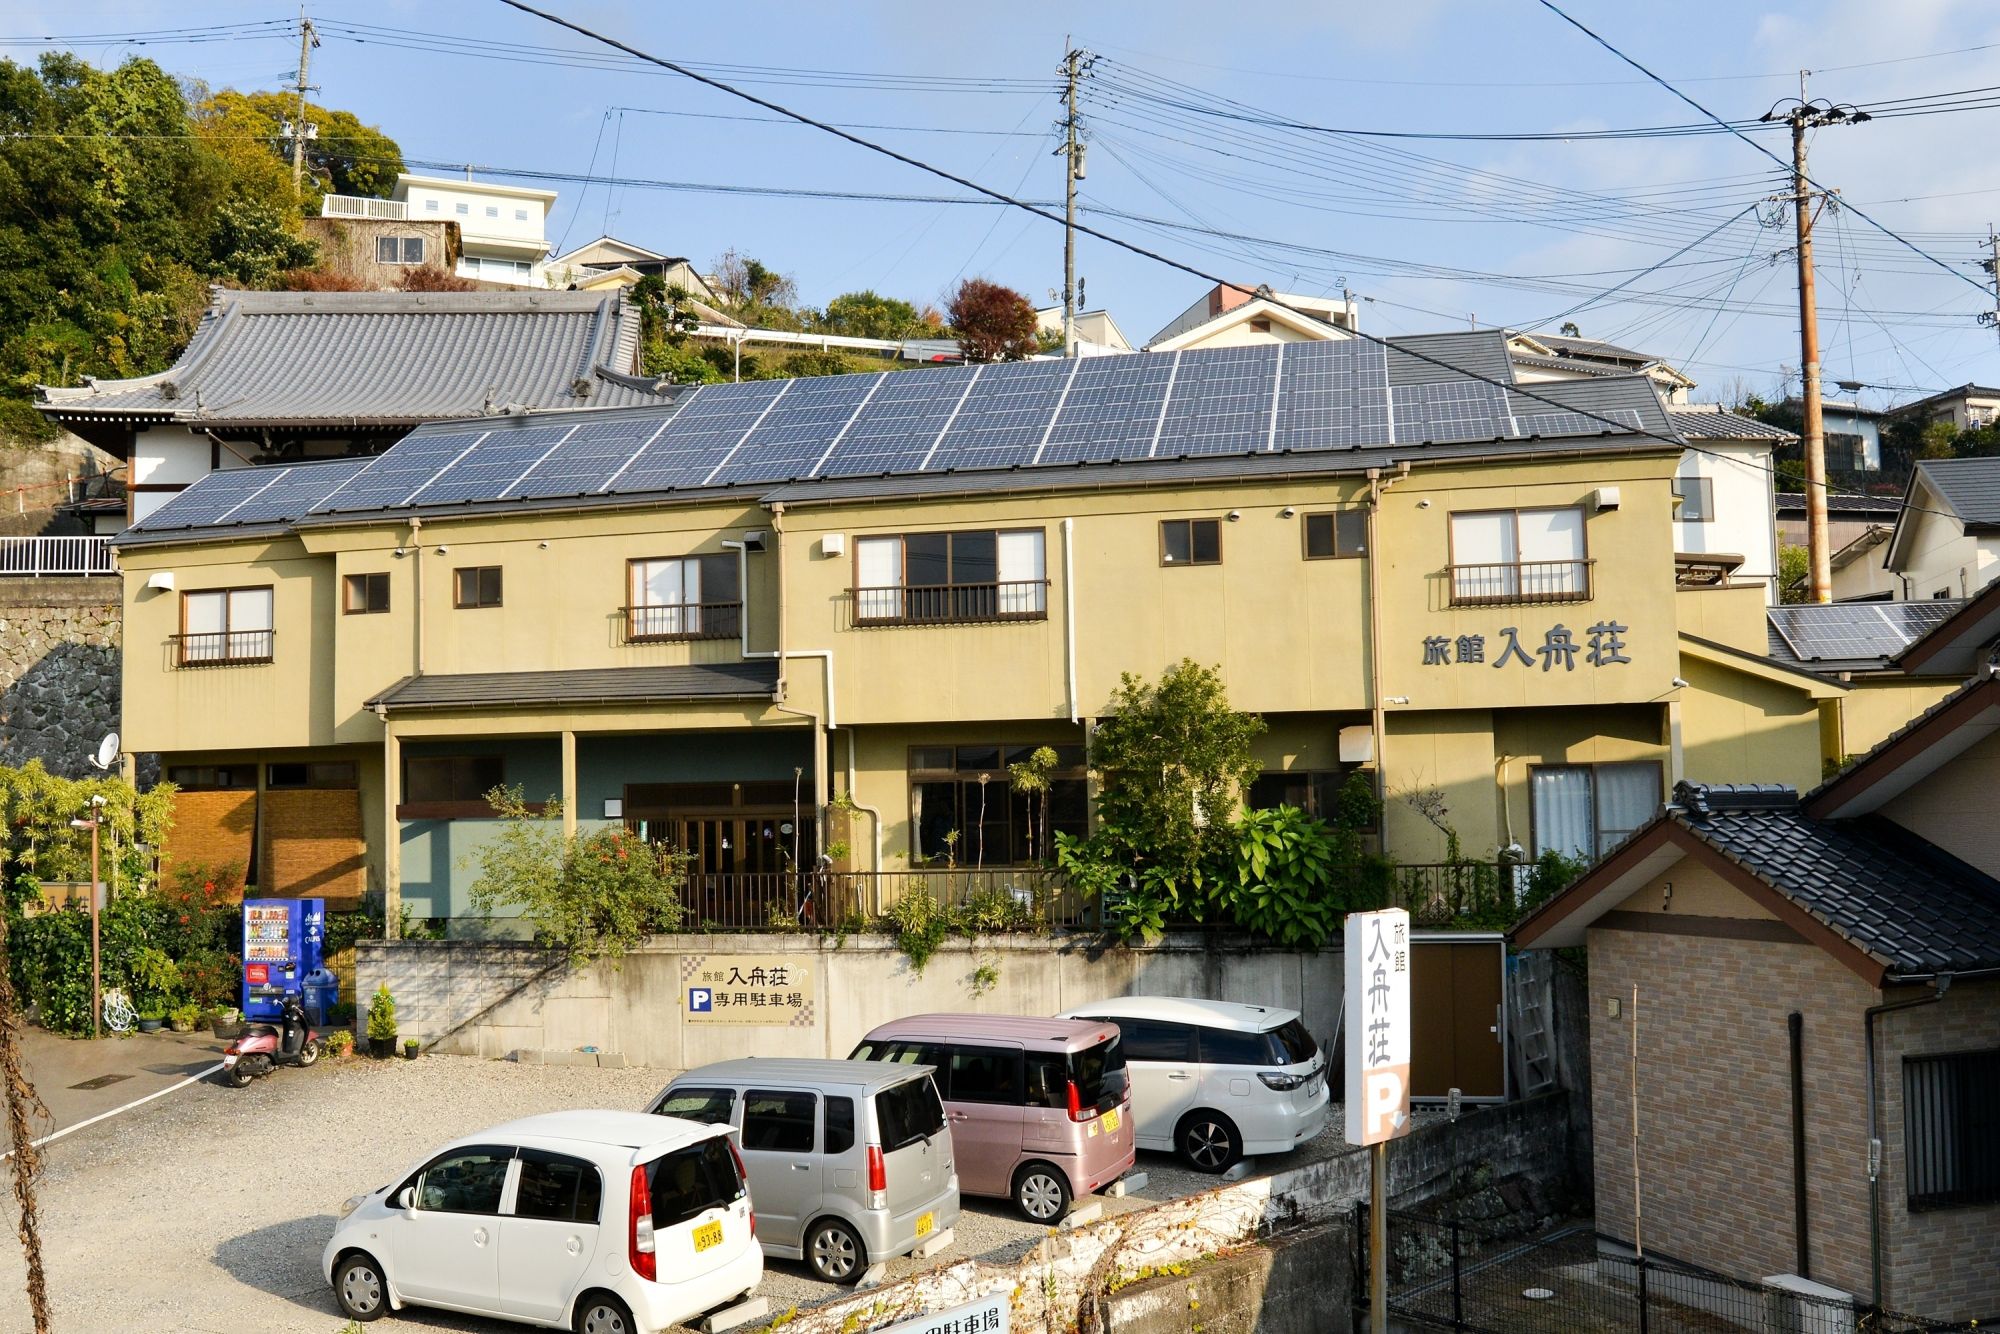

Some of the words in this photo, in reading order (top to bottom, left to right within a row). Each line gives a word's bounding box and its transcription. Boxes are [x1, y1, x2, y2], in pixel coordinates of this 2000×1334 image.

[1422, 634, 1485, 666] 旅館
[1491, 620, 1632, 672] 入舟荘
[1394, 921, 1406, 973] 旅館
[692, 990, 709, 1010] P
[714, 992, 803, 1008] 専用駐車場
[702, 971, 725, 982] 旅館
[727, 966, 789, 987] 入舟荘
[1367, 918, 1391, 1068] 入舟荘
[1367, 1071, 1403, 1136] P
